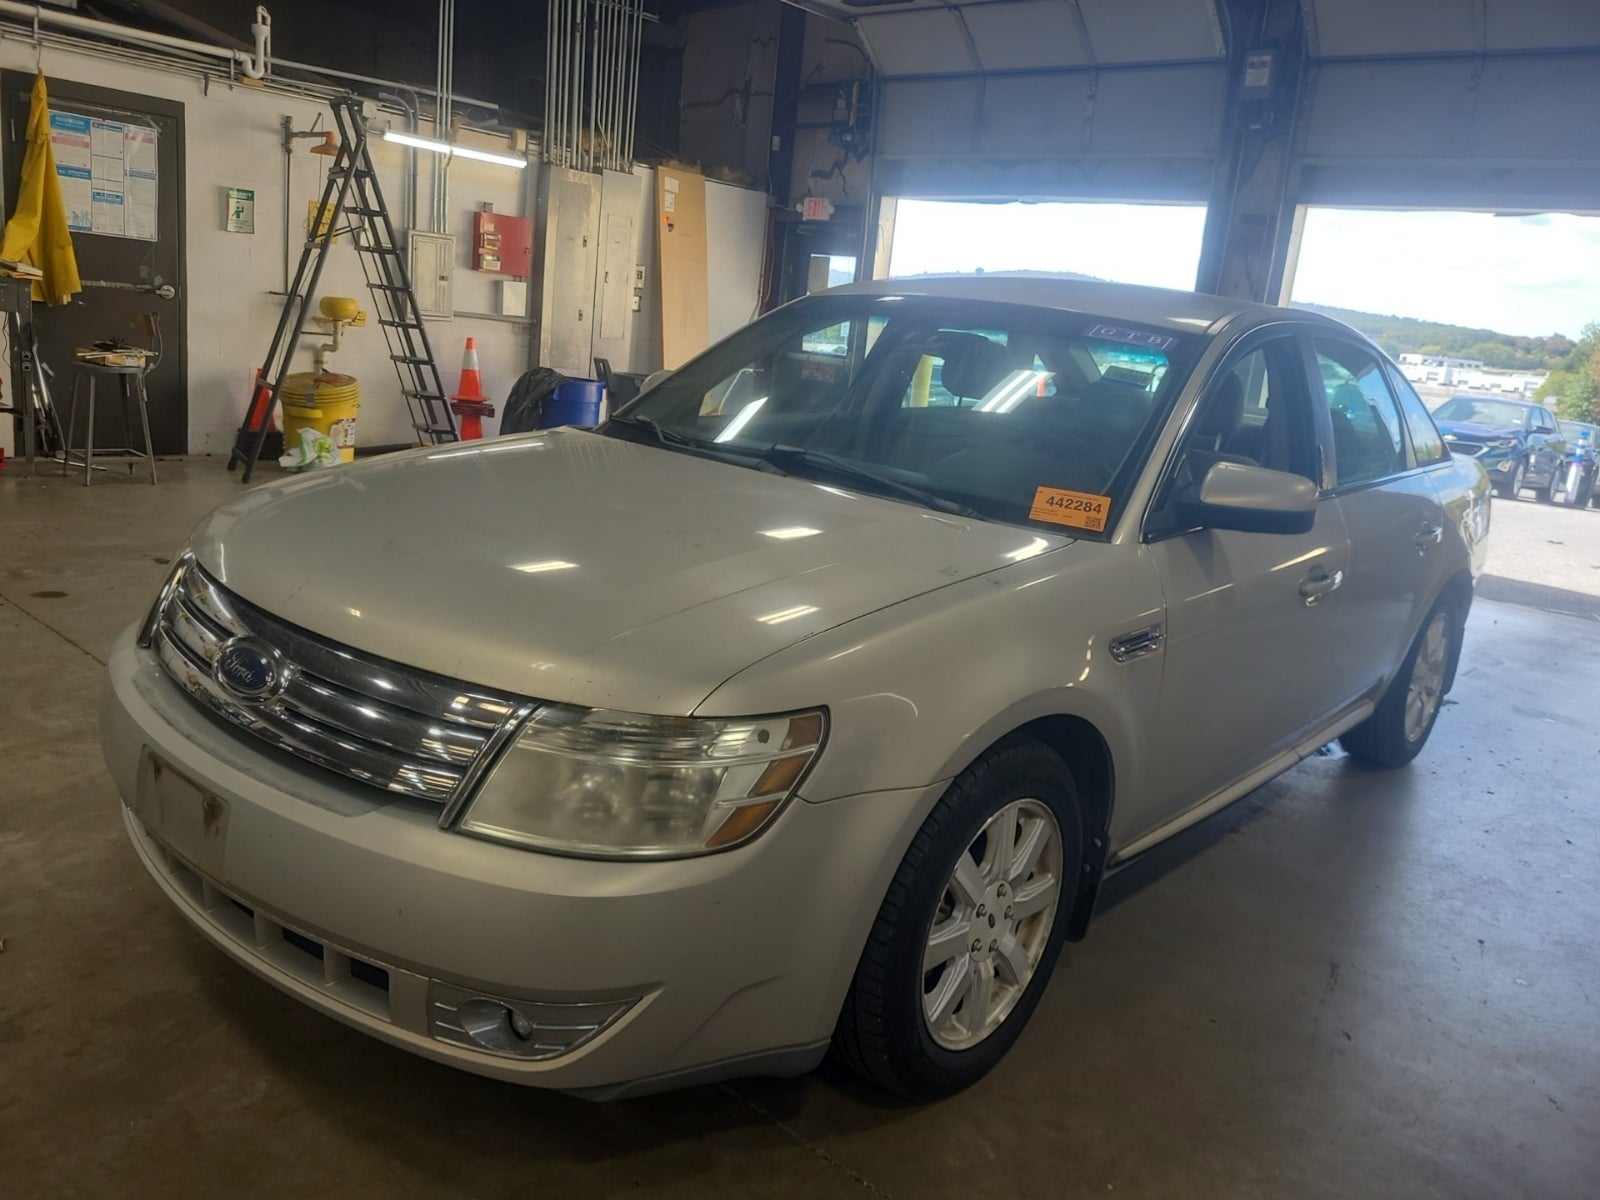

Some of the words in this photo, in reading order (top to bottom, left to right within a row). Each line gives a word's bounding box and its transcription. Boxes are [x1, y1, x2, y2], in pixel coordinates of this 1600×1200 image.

[807, 199, 827, 217] EXIT
[1046, 496, 1103, 514] 442284
[225, 652, 256, 683] Ford
